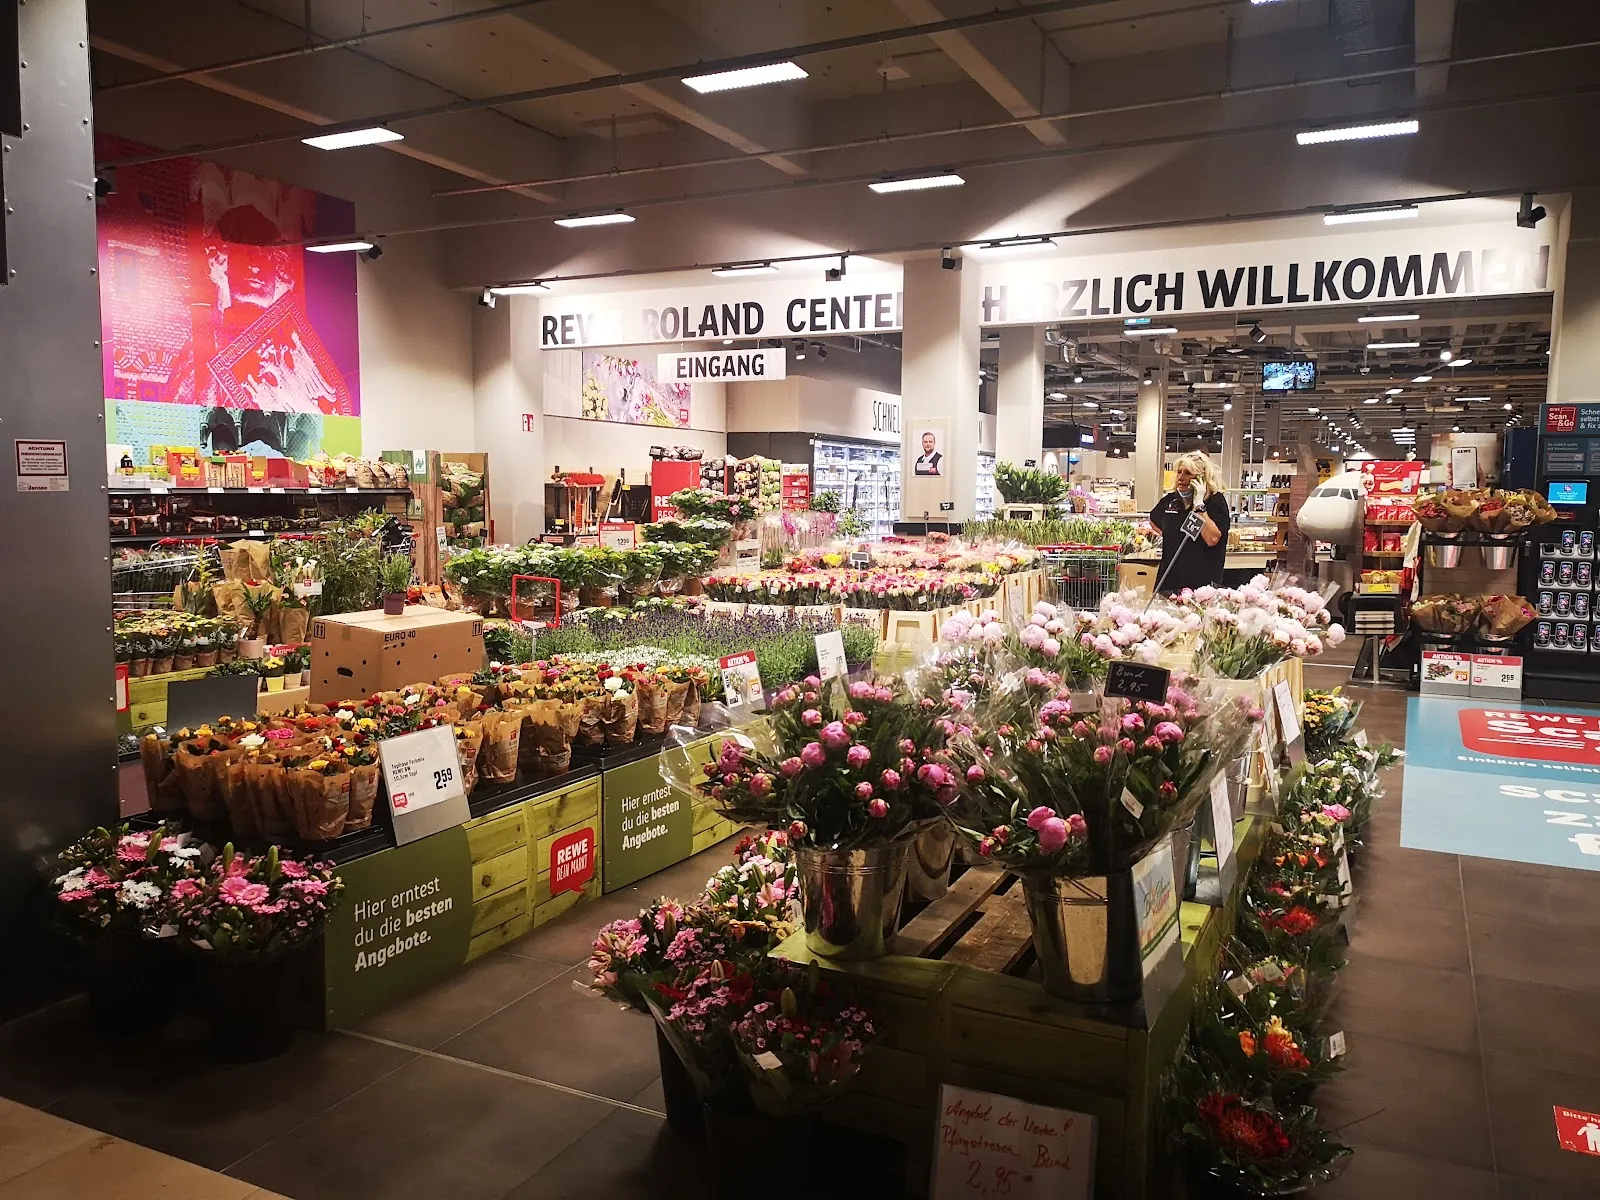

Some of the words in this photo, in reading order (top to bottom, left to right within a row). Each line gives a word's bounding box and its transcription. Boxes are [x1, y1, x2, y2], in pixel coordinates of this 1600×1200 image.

[982, 271, 1184, 321] HRZLICH
[1198, 245, 1550, 309] WILLKOMMEN
[642, 300, 764, 340] ROLAND
[677, 353, 764, 378] EINGANG
[384, 631, 407, 642] EURO
[407, 630, 416, 639] 40
[1432, 653, 1454, 661] AKTION
[1115, 665, 1145, 678] Bund
[1483, 710, 1586, 725] REWE
[1457, 755, 1537, 768] Einkäufe
[621, 796, 641, 813] Hier
[642, 785, 672, 806] erntest
[621, 816, 634, 832] du
[636, 810, 650, 827] die
[651, 800, 680, 821] besten
[622, 824, 668, 851] Angebote.
[557, 837, 589, 866] REWE
[556, 862, 570, 882] DEIN
[570, 853, 588, 876] MARKT
[354, 898, 387, 923] Hier
[391, 876, 441, 909] erntest
[354, 926, 374, 947] du
[379, 916, 401, 938] die
[406, 896, 453, 928] besten
[354, 930, 432, 972] Angebote.
[946, 1100, 993, 1126] Angebot
[997, 1111, 1020, 1127] der
[1562, 1110, 1588, 1121] Bitte
[1034, 1144, 1072, 1171] Bund
